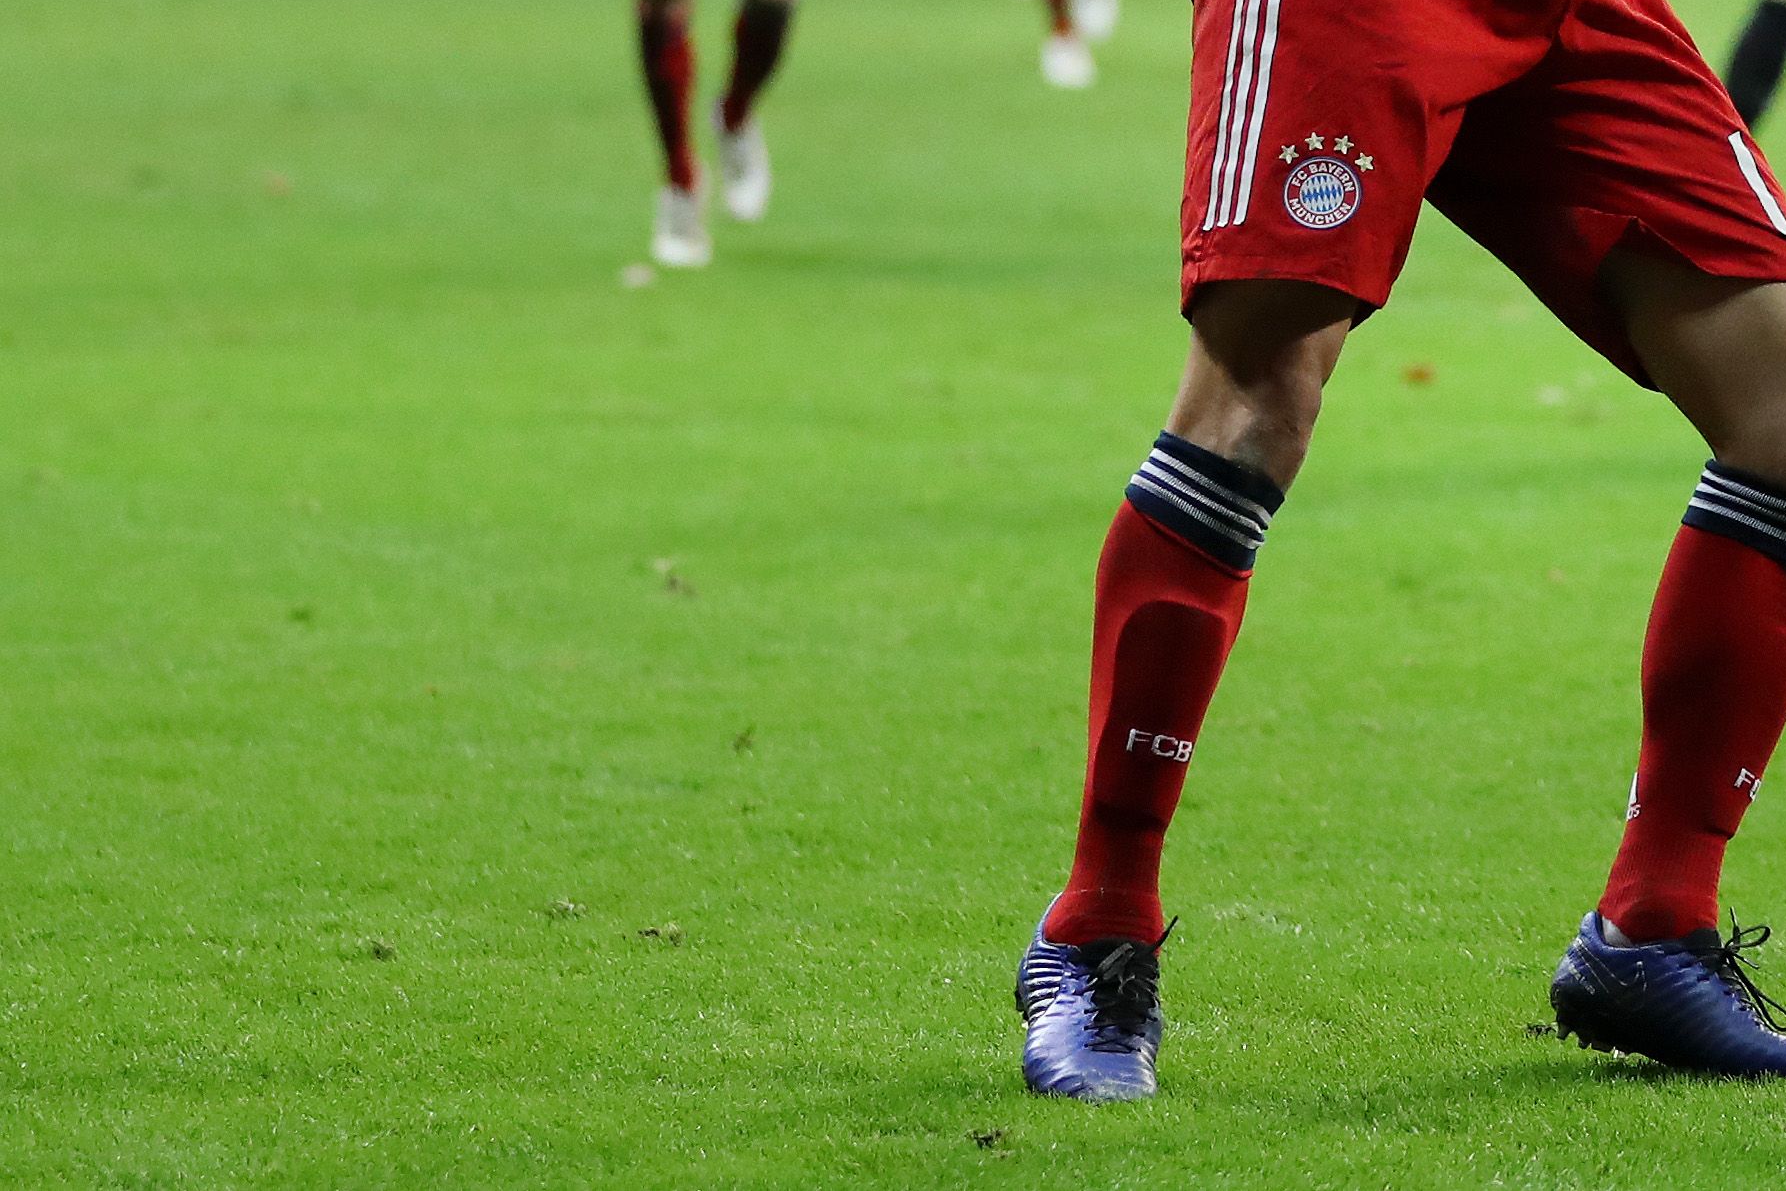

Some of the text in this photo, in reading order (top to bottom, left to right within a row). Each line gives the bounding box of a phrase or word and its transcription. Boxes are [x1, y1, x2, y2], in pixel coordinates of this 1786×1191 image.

[1292, 162, 1355, 192] FC BAYERN
[1126, 728, 1192, 762] FCB
